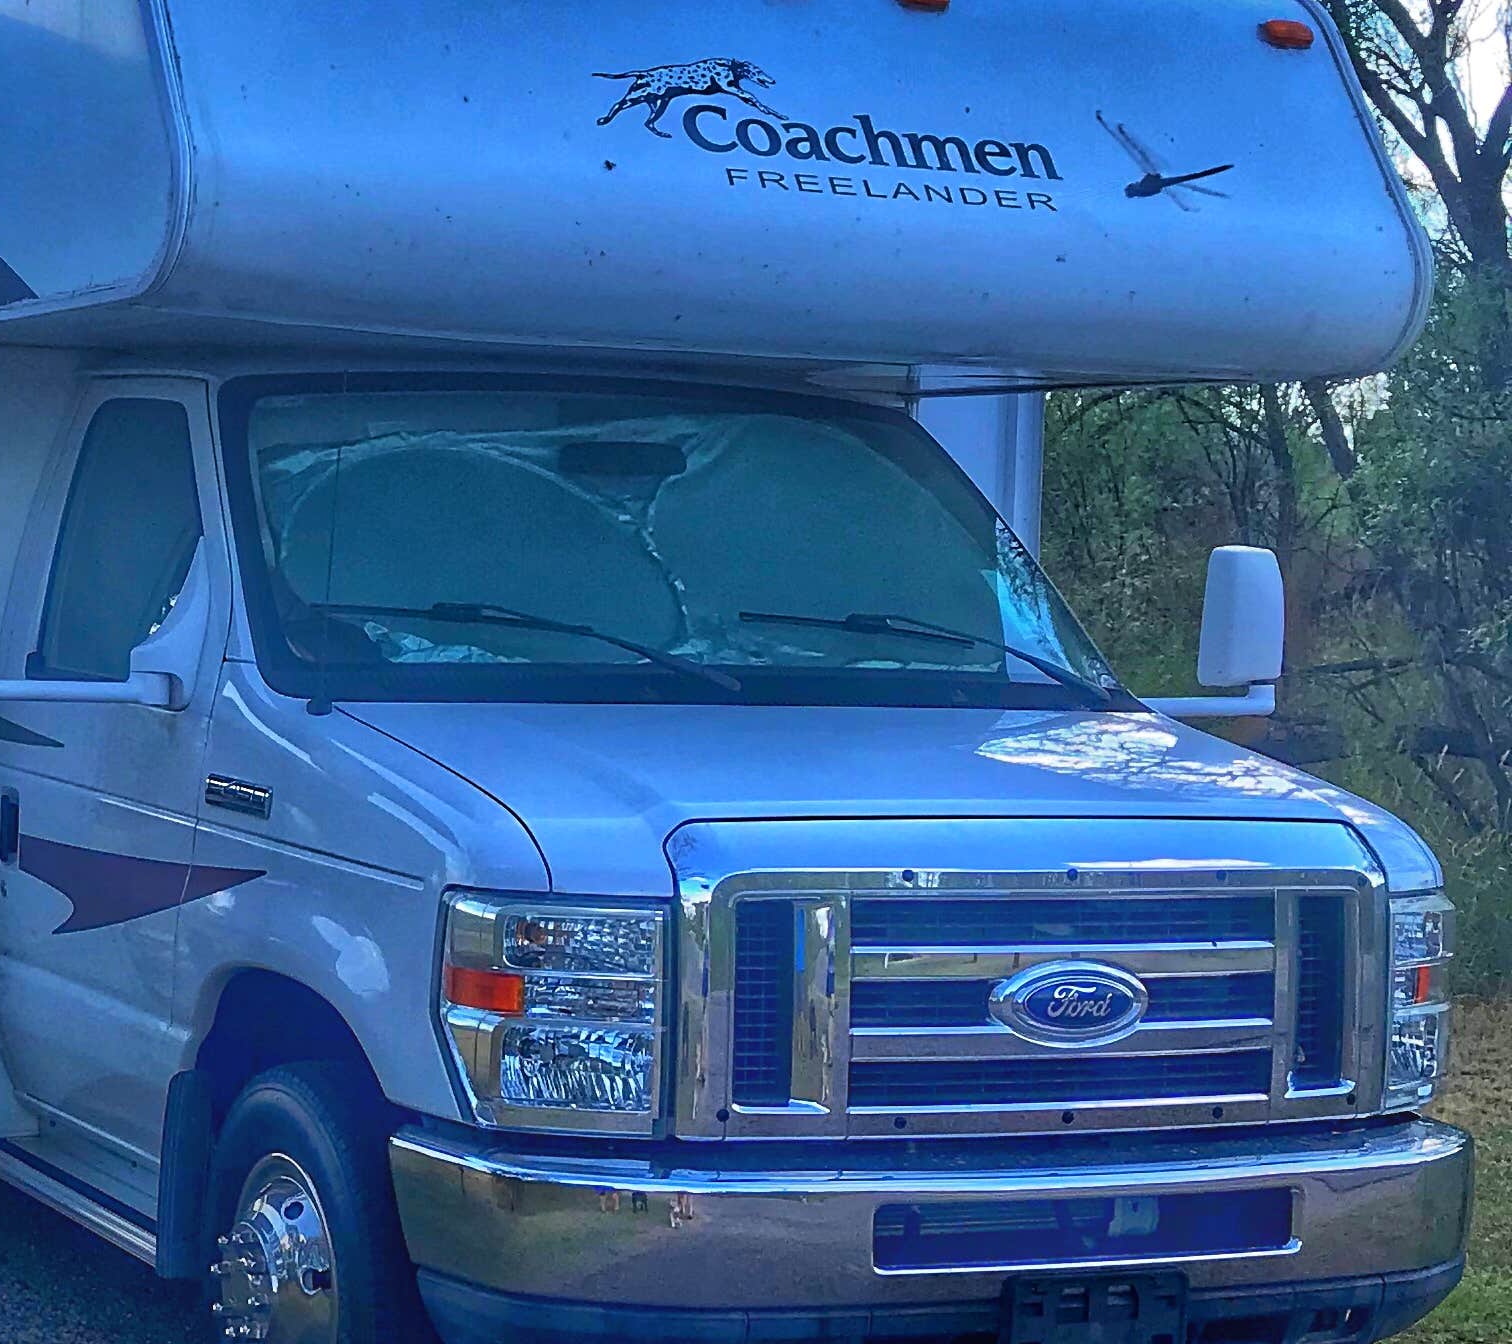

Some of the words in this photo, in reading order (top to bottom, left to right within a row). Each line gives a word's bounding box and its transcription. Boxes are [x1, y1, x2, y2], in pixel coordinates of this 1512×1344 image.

[682, 104, 1064, 181] Coachmen
[726, 168, 1058, 212] FREELANDER
[1046, 985, 1112, 1018] Ford
